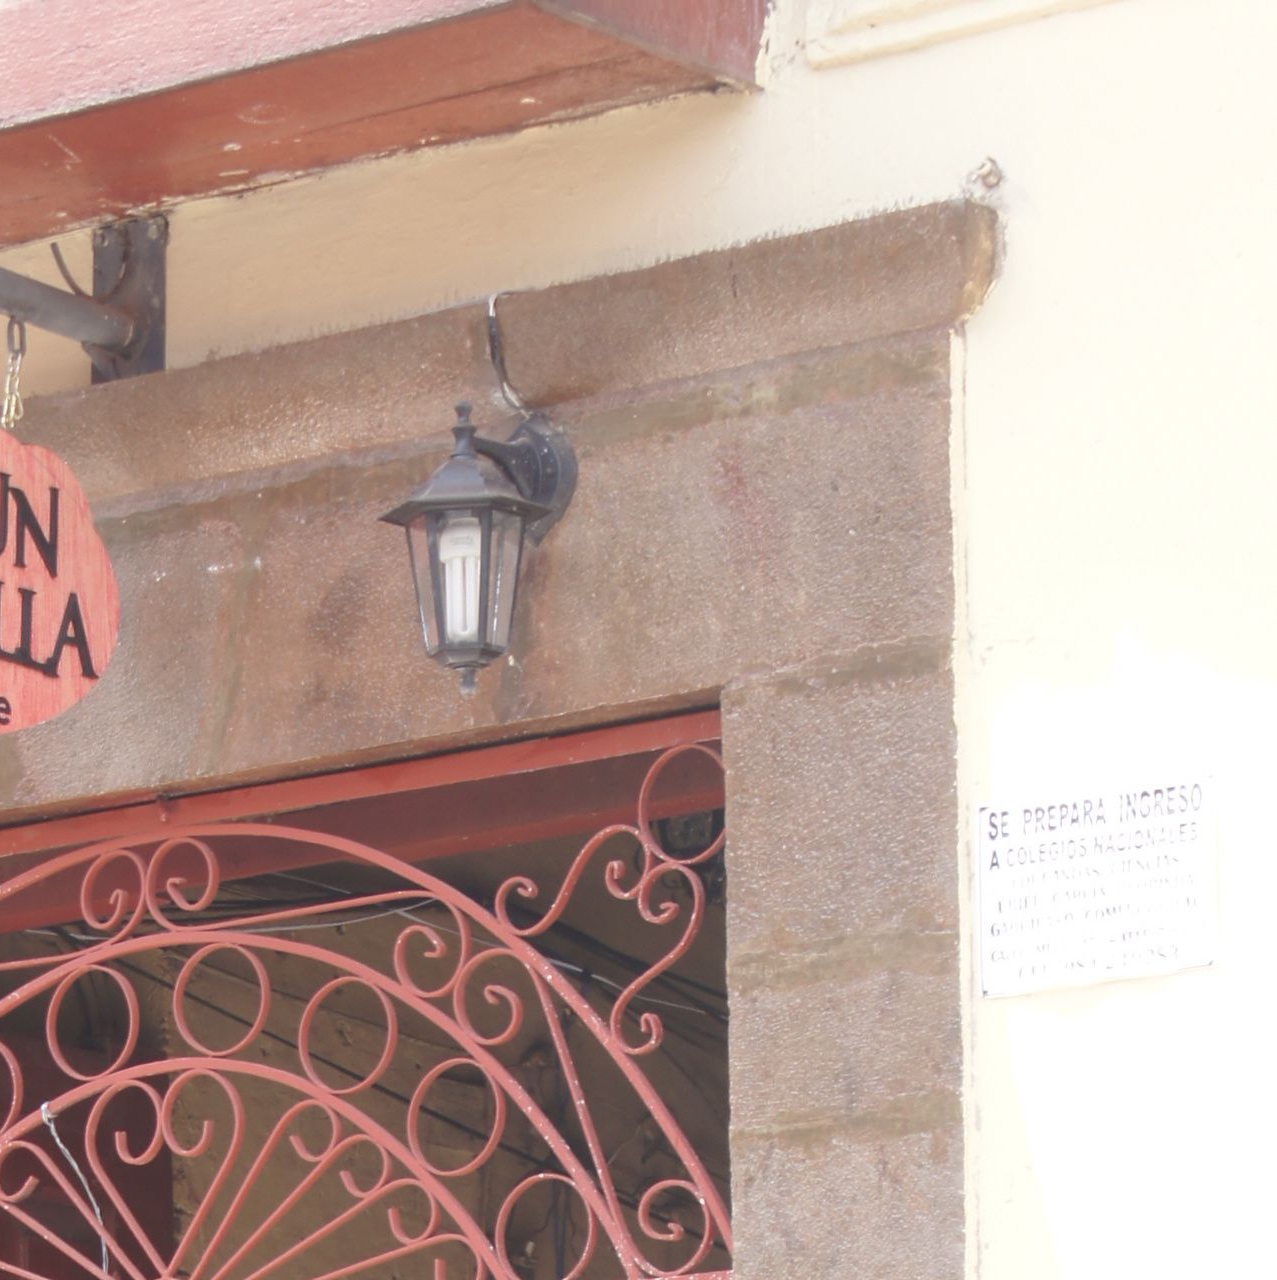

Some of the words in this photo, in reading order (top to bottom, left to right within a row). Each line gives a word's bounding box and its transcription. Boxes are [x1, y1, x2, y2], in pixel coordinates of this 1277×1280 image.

[987, 810, 1011, 842] SE
[1022, 797, 1107, 835] PREPARA
[1118, 783, 1203, 823] INGRESO
[988, 848, 1001, 872] A
[1005, 838, 1088, 868] COLEGIOS
[1093, 822, 1199, 855] NACIONALES
